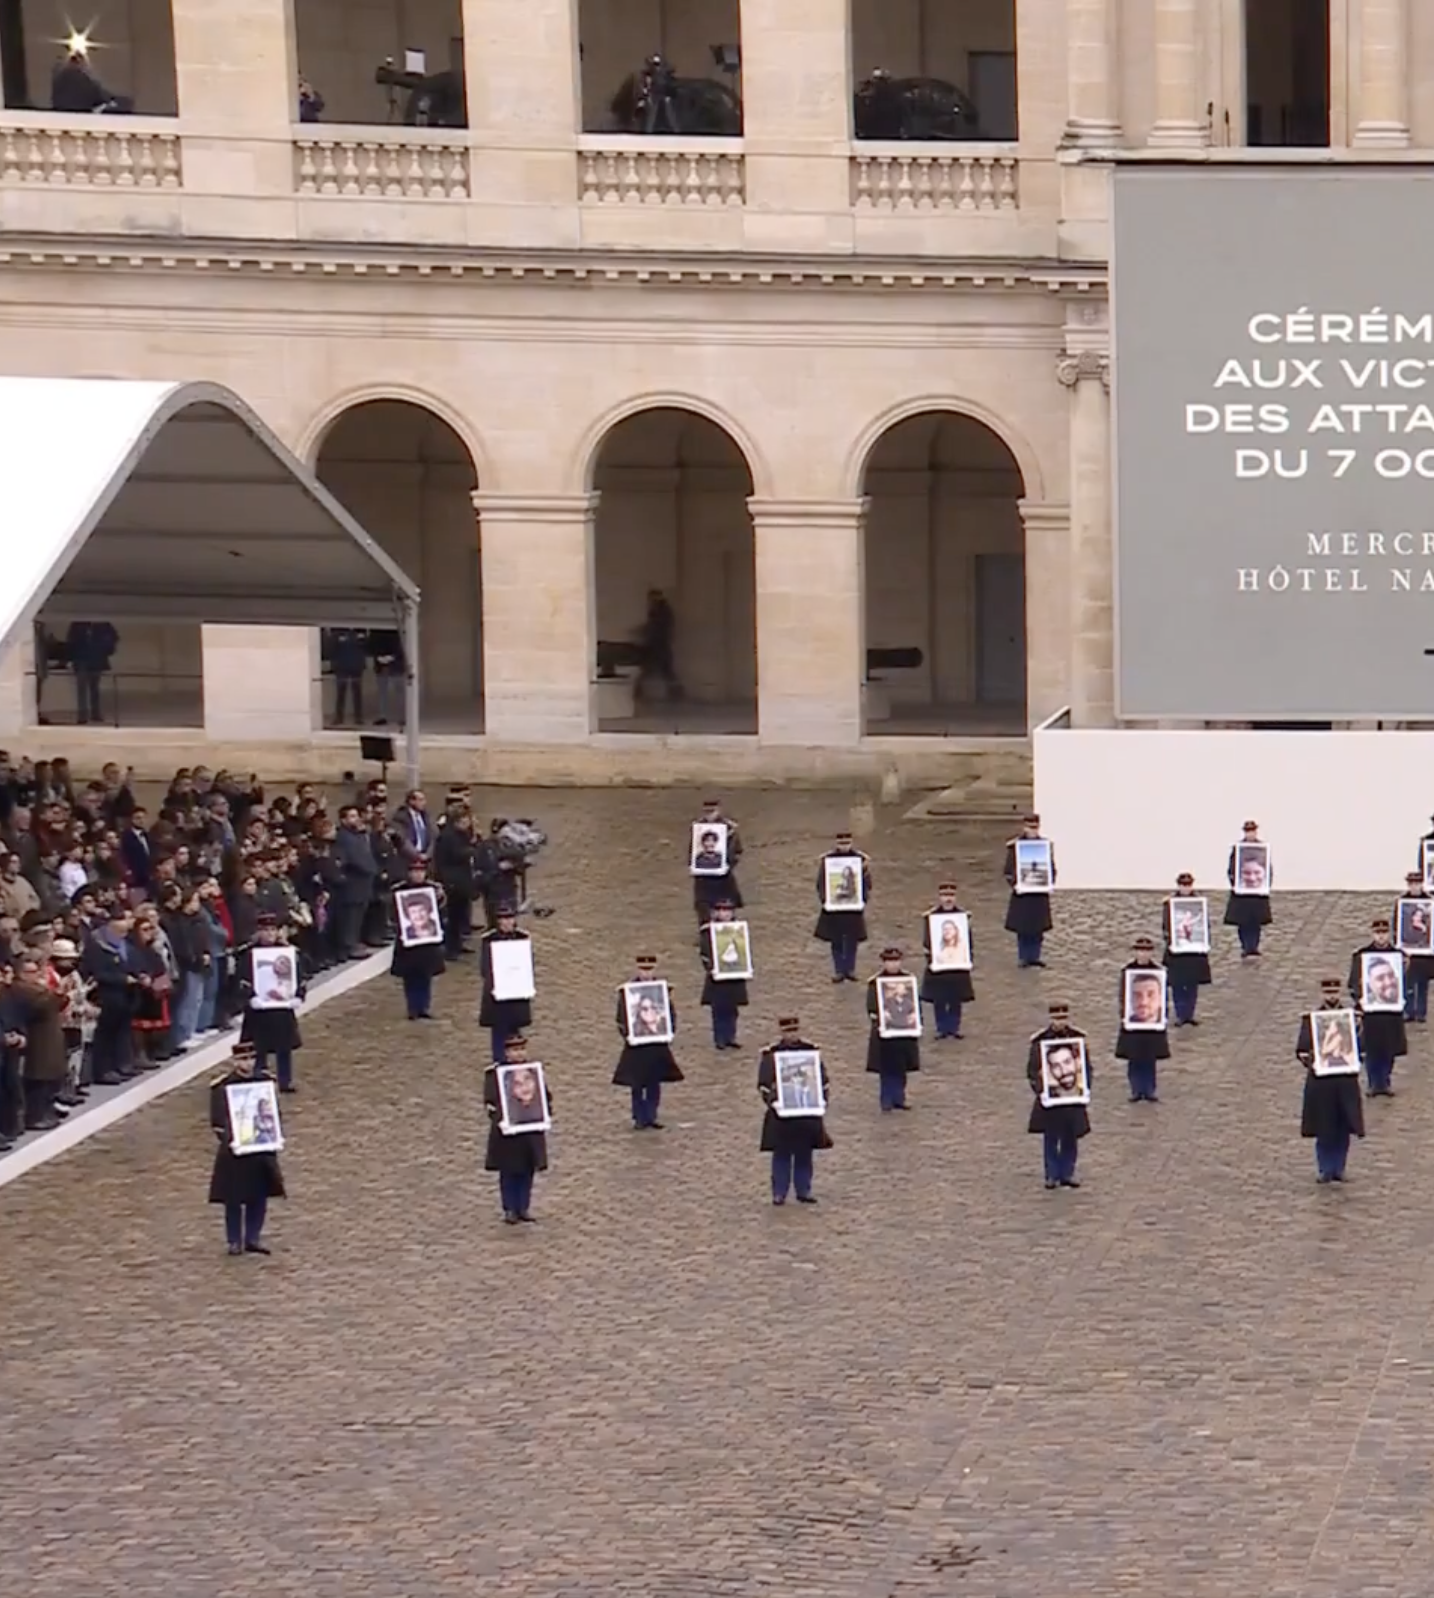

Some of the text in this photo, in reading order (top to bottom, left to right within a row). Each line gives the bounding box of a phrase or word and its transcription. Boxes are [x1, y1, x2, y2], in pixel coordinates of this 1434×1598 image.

[1213, 359, 1324, 388] AUX
[1185, 404, 1290, 433] DES
[1235, 449, 1308, 478] DU
[1326, 450, 1357, 478] 7
[1237, 565, 1368, 591] HÔTEL
